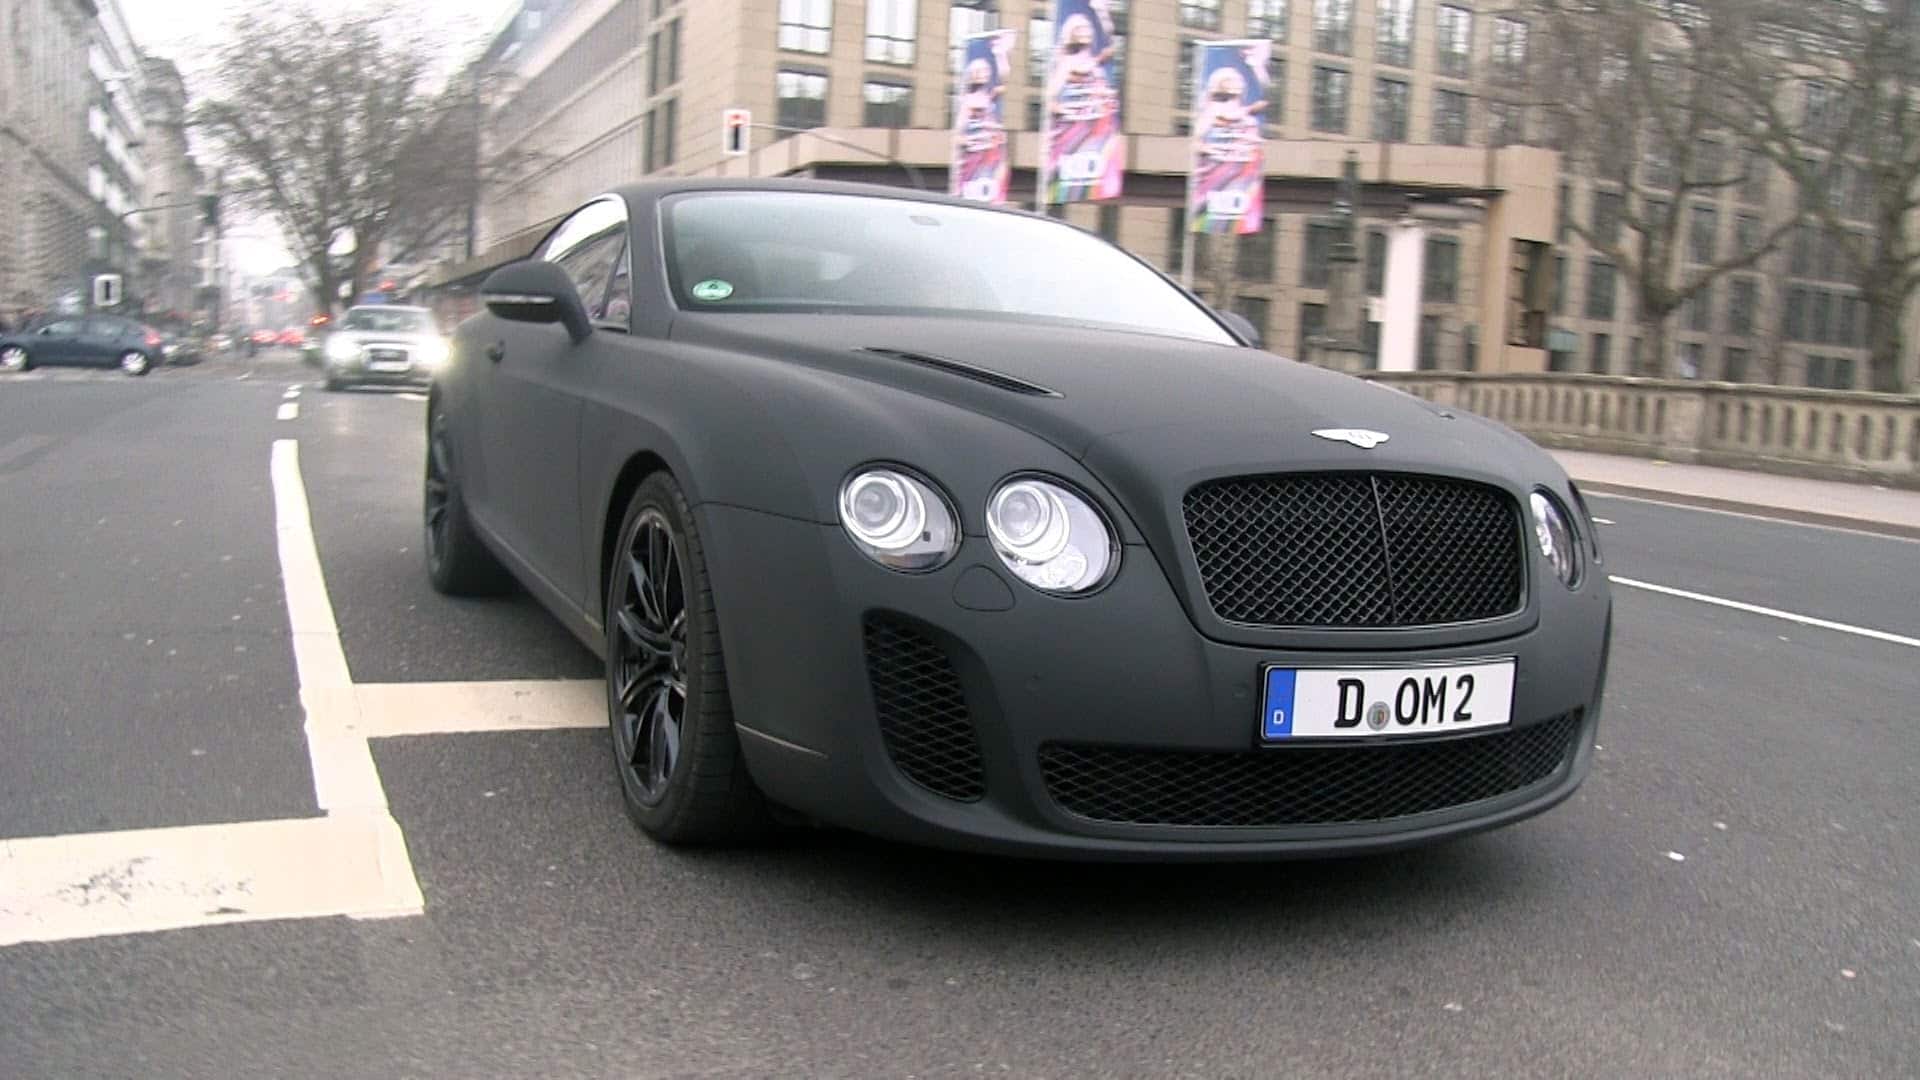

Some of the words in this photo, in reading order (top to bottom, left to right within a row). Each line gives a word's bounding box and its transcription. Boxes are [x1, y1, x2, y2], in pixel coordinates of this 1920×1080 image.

[1272, 710, 1284, 724] D
[1333, 678, 1365, 728] D
[1395, 675, 1447, 726] OM
[1453, 674, 1475, 722] 2
